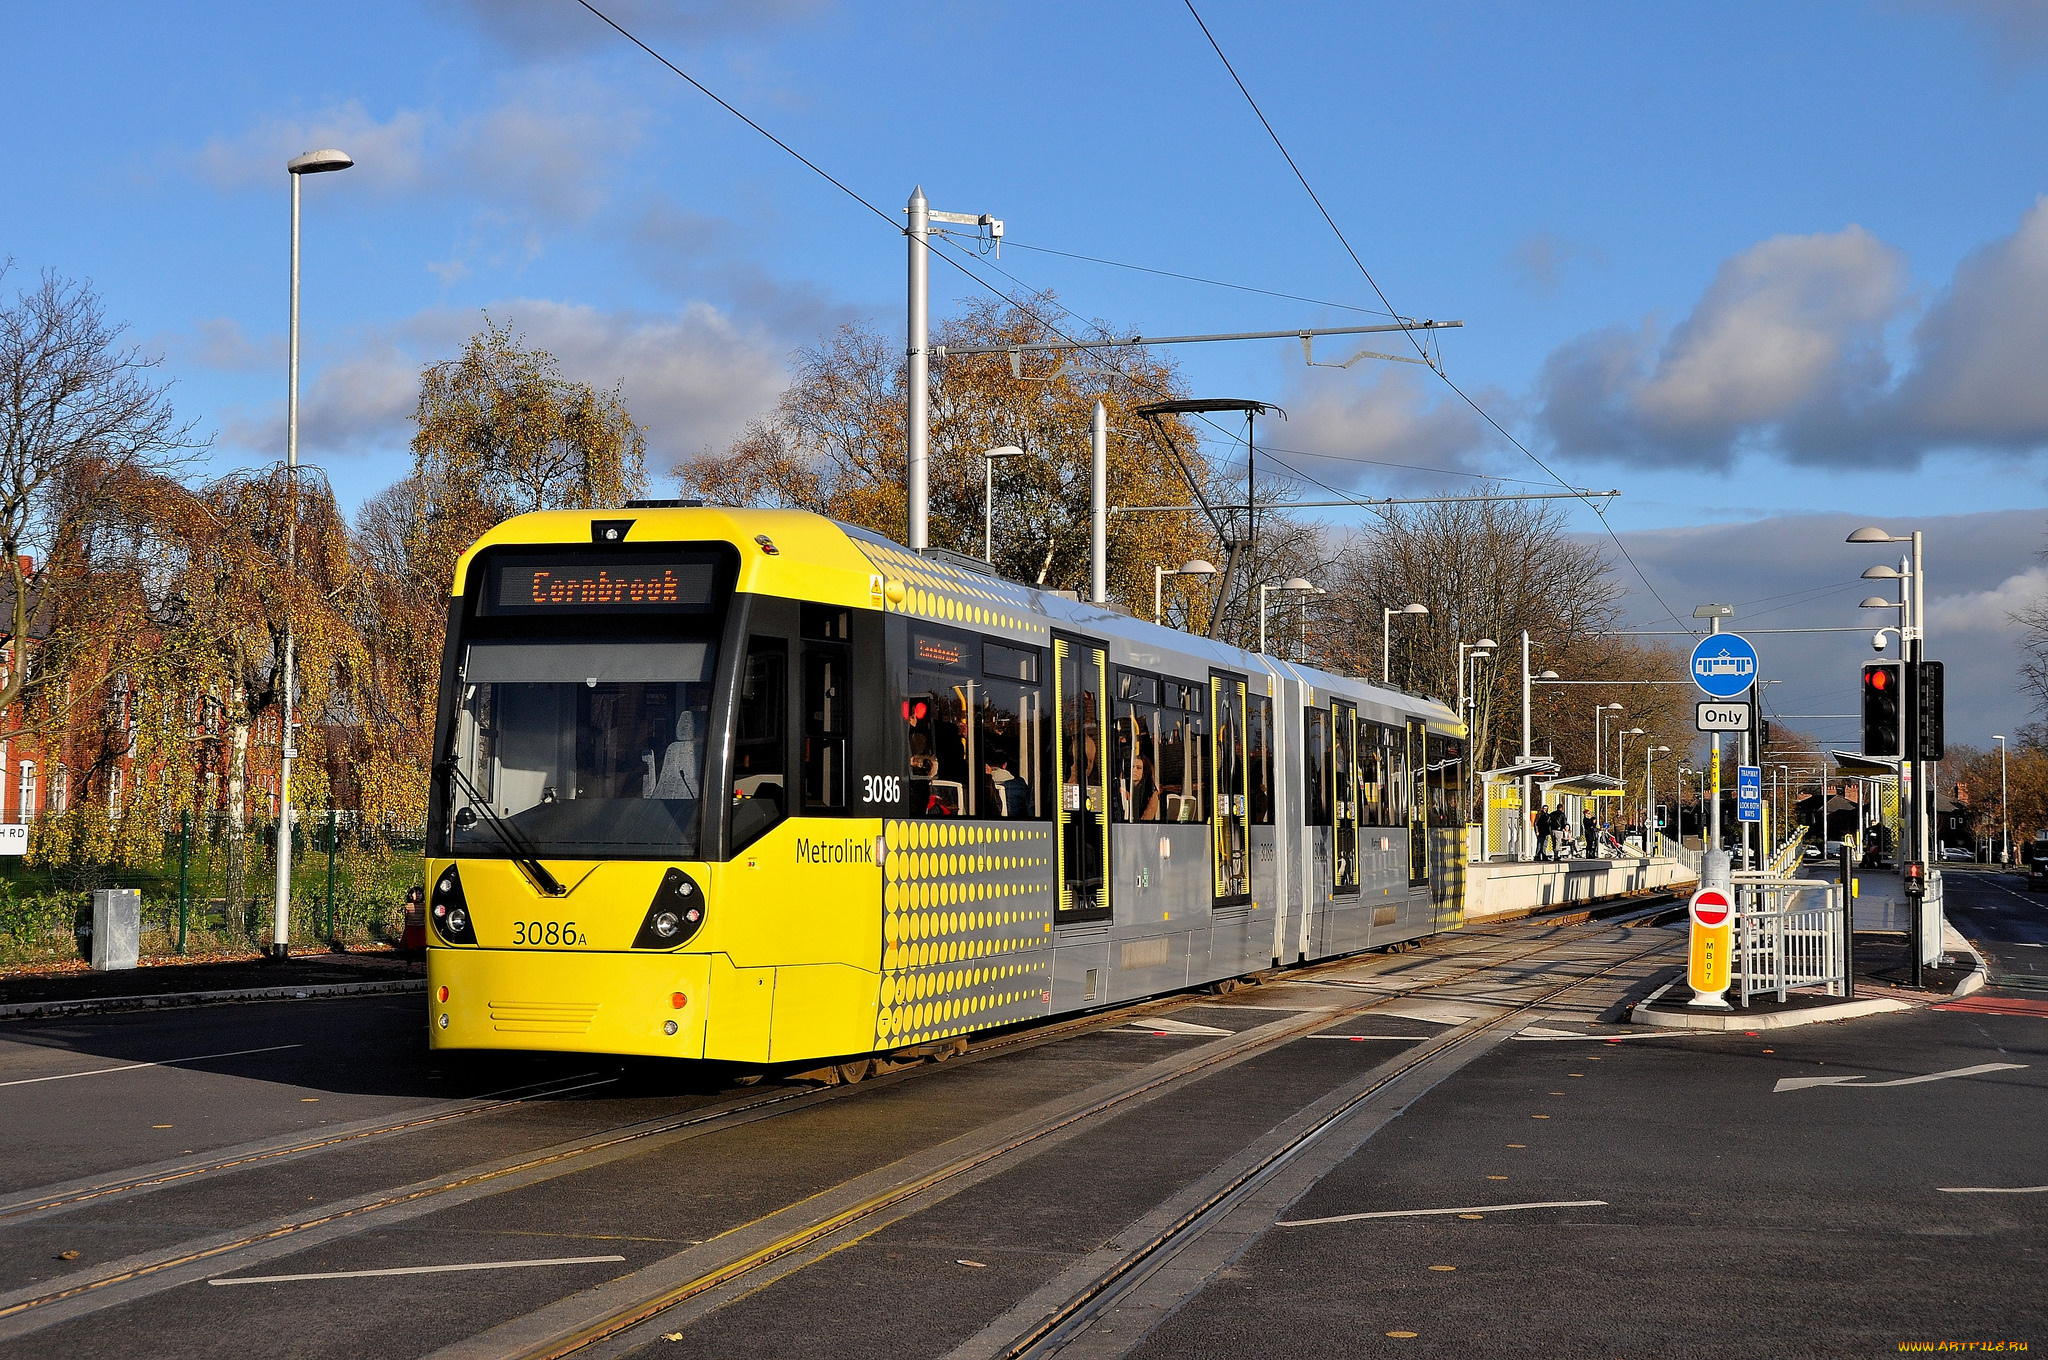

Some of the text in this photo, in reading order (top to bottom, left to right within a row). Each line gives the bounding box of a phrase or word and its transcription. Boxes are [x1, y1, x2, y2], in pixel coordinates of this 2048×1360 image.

[532, 570, 678, 602] Cornbrook
[1705, 710, 1742, 725] Only
[1740, 769, 1758, 778] TRAMWAY
[862, 774, 900, 803] 3086
[1739, 802, 1750, 810] LOOK
[9, 828, 25, 838] RD
[796, 838, 872, 864] Metrolink
[512, 921, 587, 946] 3086A
[1705, 942, 1714, 980] MB07
